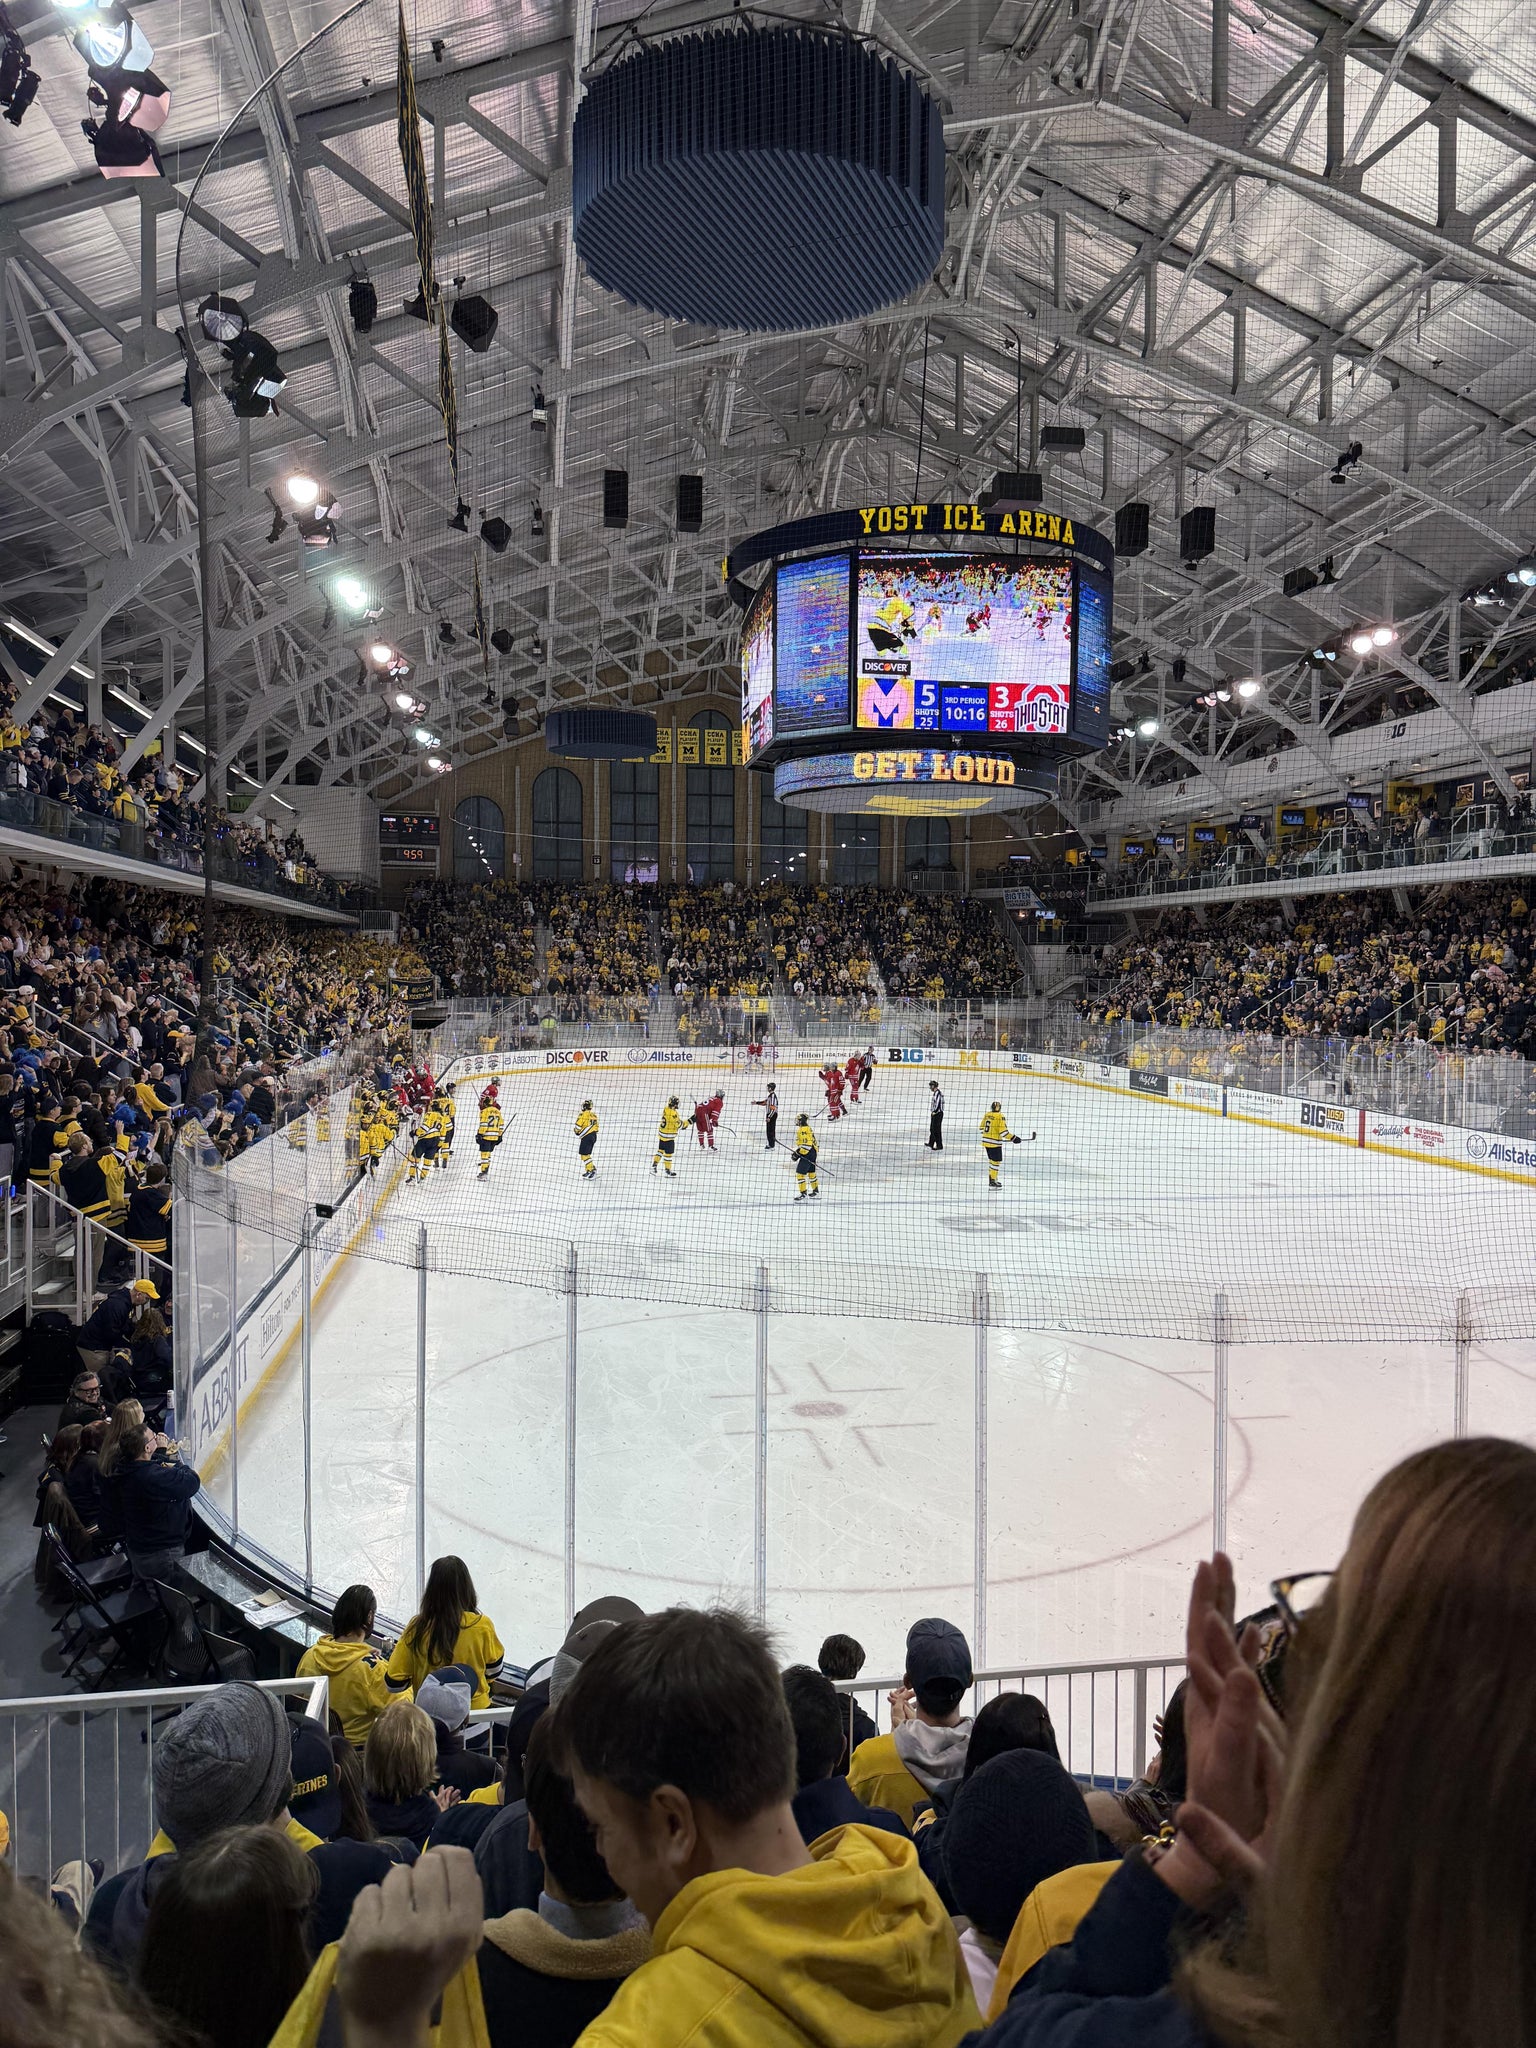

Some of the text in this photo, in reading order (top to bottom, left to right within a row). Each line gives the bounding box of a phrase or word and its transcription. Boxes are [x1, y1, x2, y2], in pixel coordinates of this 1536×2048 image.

[859, 504, 1075, 545] YOST ICE ARENA
[864, 662, 908, 672] DISCOVER
[920, 684, 936, 706] 5
[944, 696, 959, 704] 3RD
[994, 686, 1009, 708] 3
[915, 708, 940, 716] SHOTS
[945, 707, 986, 720] 10:16
[990, 710, 1014, 718] SHOTS
[1039, 698, 1067, 728] STAT
[920, 717, 933, 727] 25
[994, 719, 1008, 729] 26
[853, 752, 1016, 785] GET LOUD
[546, 1051, 609, 1065] DISCOVER
[649, 1051, 693, 1062] Allstate
[797, 1051, 821, 1059] Hilton
[1300, 1102, 1345, 1128] BIG 1050
[1325, 1120, 1345, 1133] WTKA
[1487, 1143, 1536, 1168] Allstate
[261, 1309, 282, 1348] Hilton
